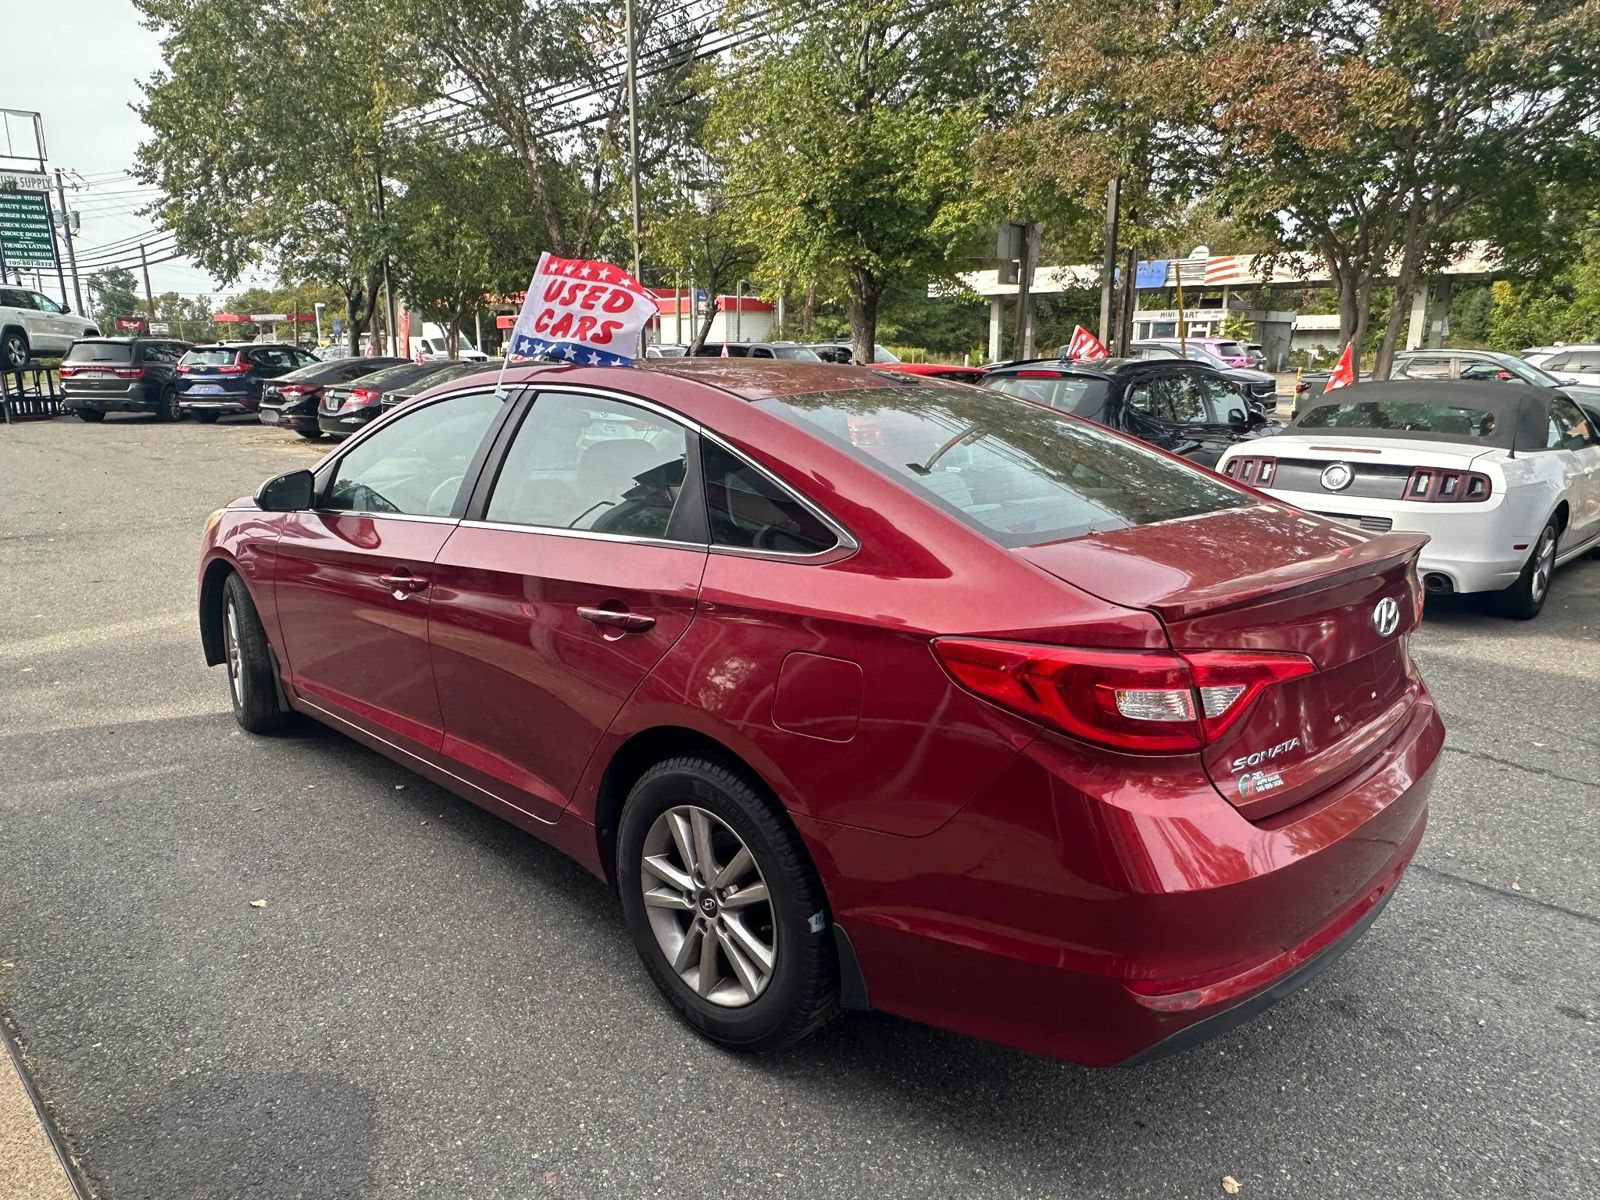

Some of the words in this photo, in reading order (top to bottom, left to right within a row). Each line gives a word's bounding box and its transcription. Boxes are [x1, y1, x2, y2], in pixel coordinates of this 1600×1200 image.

[20, 176, 51, 189] SUPPLY
[543, 279, 634, 313] USED
[535, 308, 624, 344] CARS
[1231, 737, 1300, 773] SONATA
